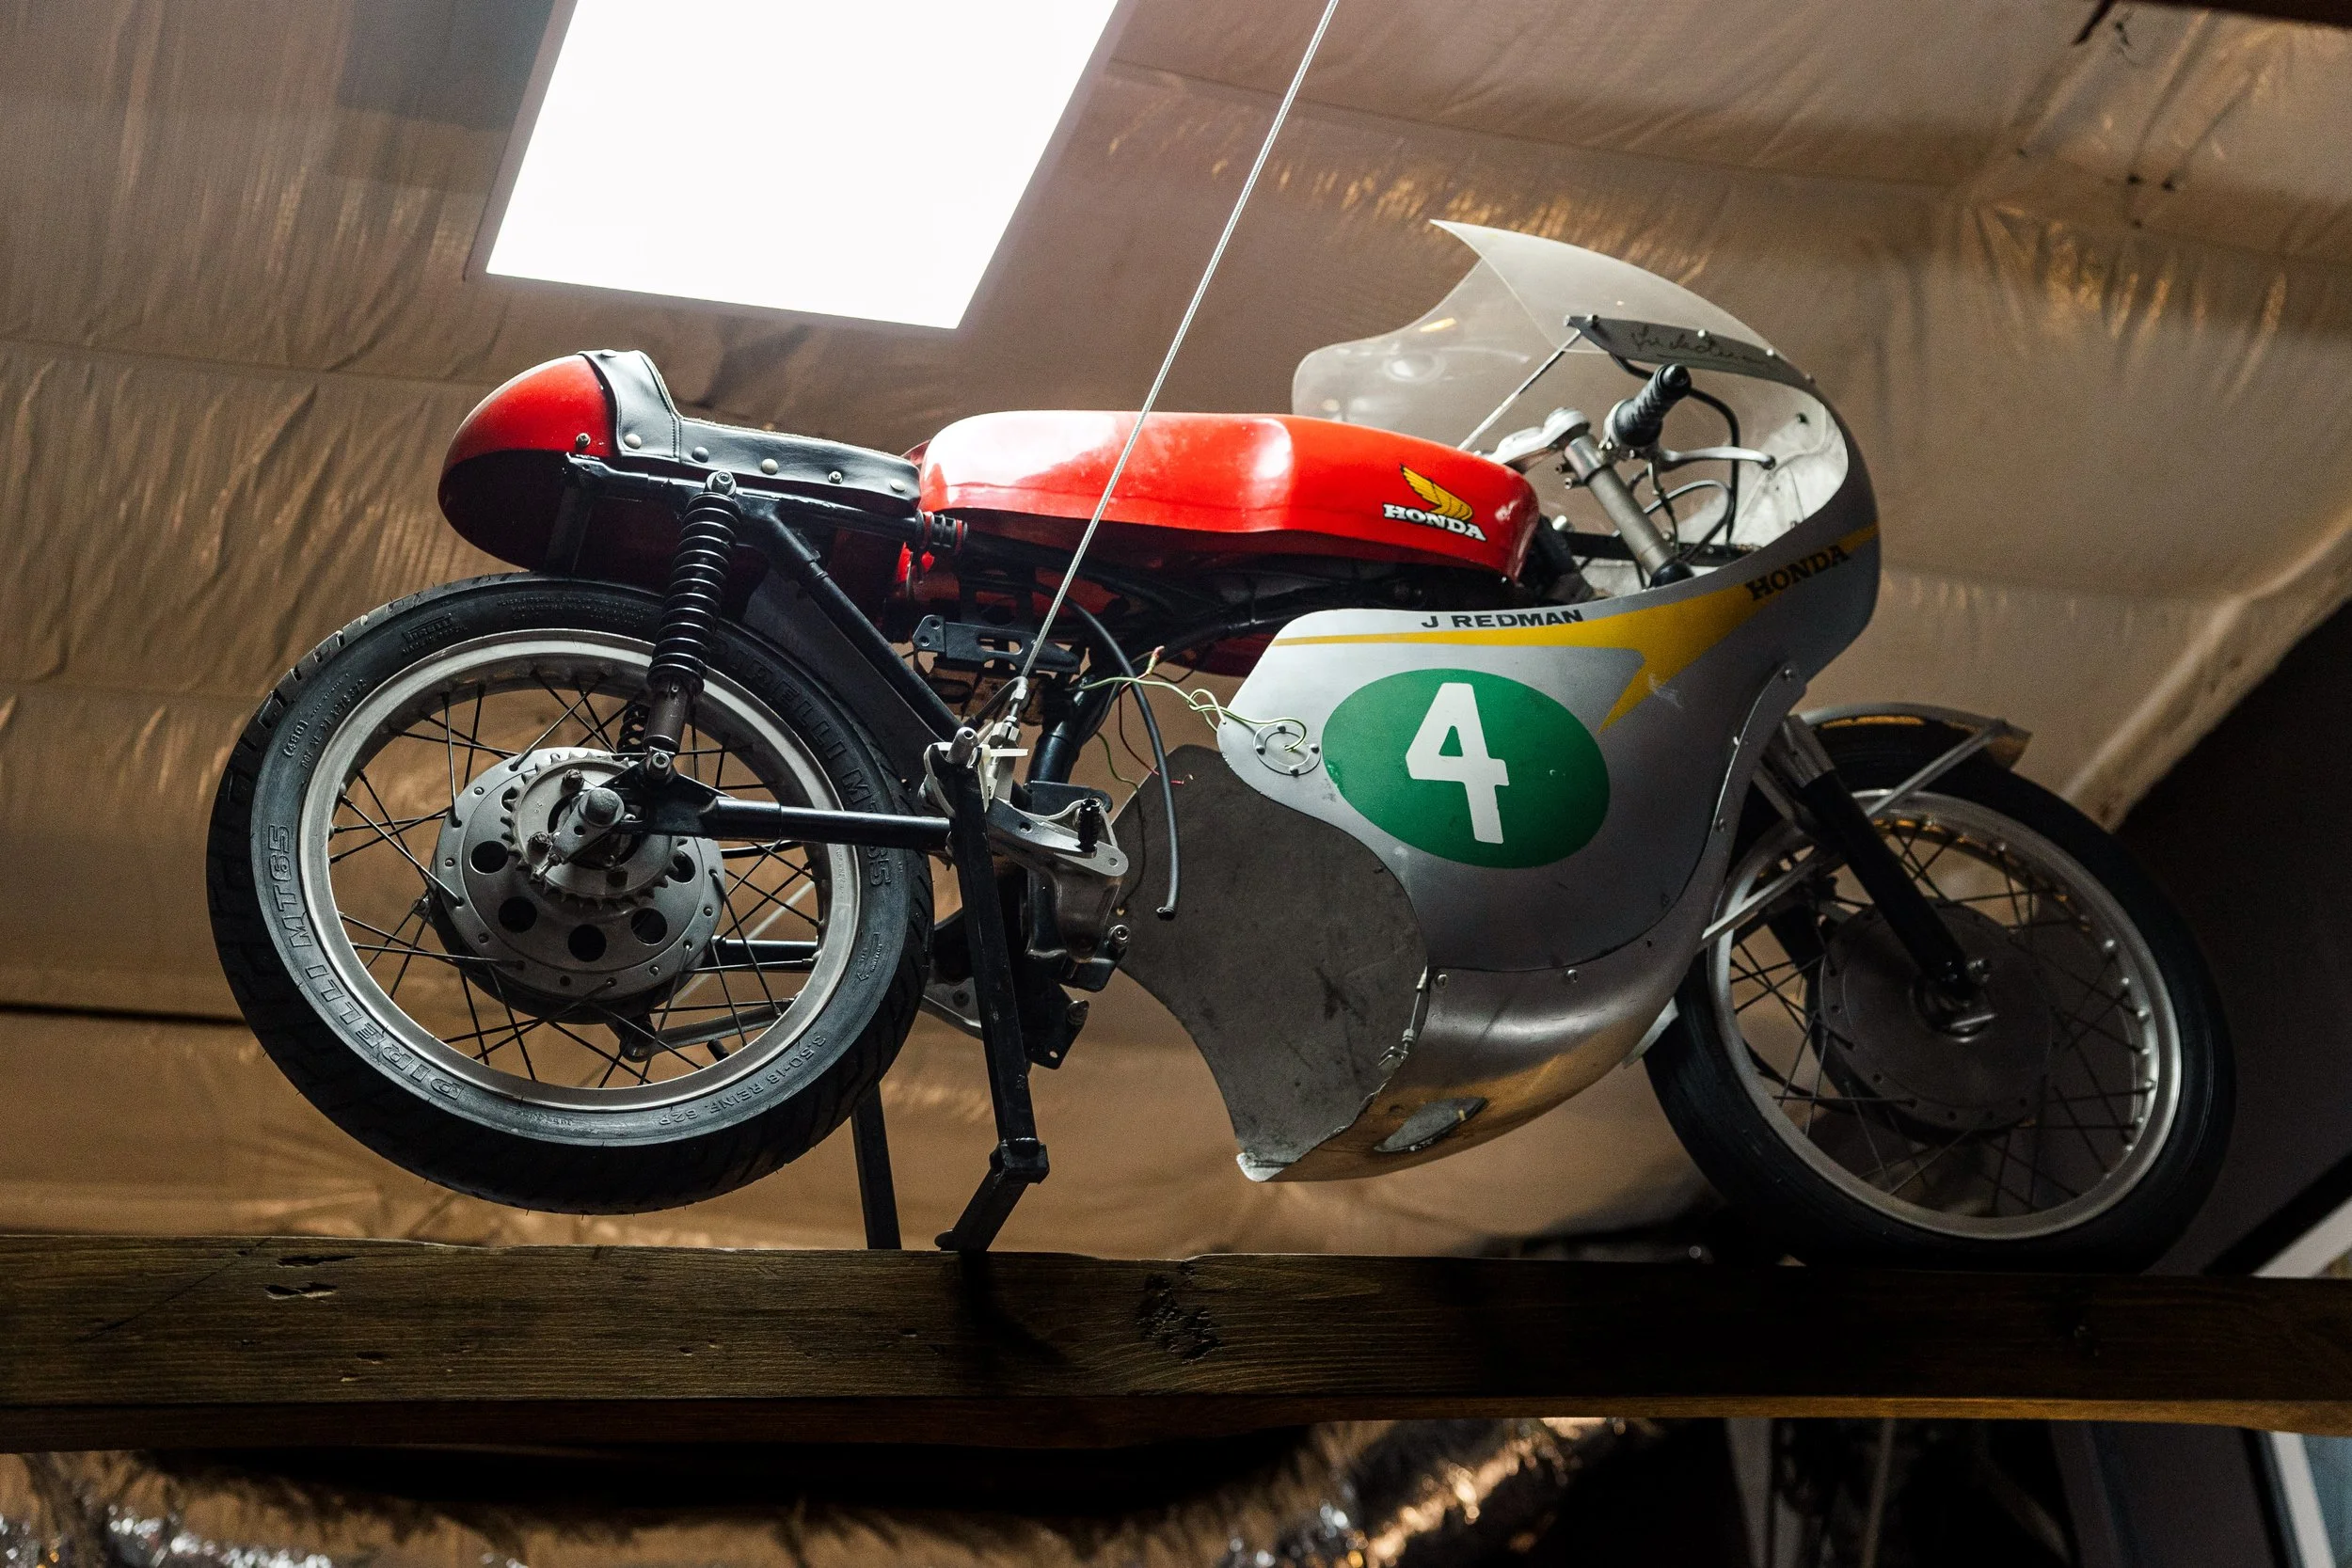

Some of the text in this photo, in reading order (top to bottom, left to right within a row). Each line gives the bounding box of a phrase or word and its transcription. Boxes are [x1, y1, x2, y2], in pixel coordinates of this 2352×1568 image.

[1383, 503, 1486, 542] HONDA
[1746, 545, 1849, 601] HONDA
[1421, 609, 1584, 628] J REDMAN
[1405, 682, 1510, 845] 4
[269, 824, 465, 1100] PIRELLI MT65
[767, 1031, 826, 1085] 3.50-18
[705, 1083, 764, 1114] REINF.
